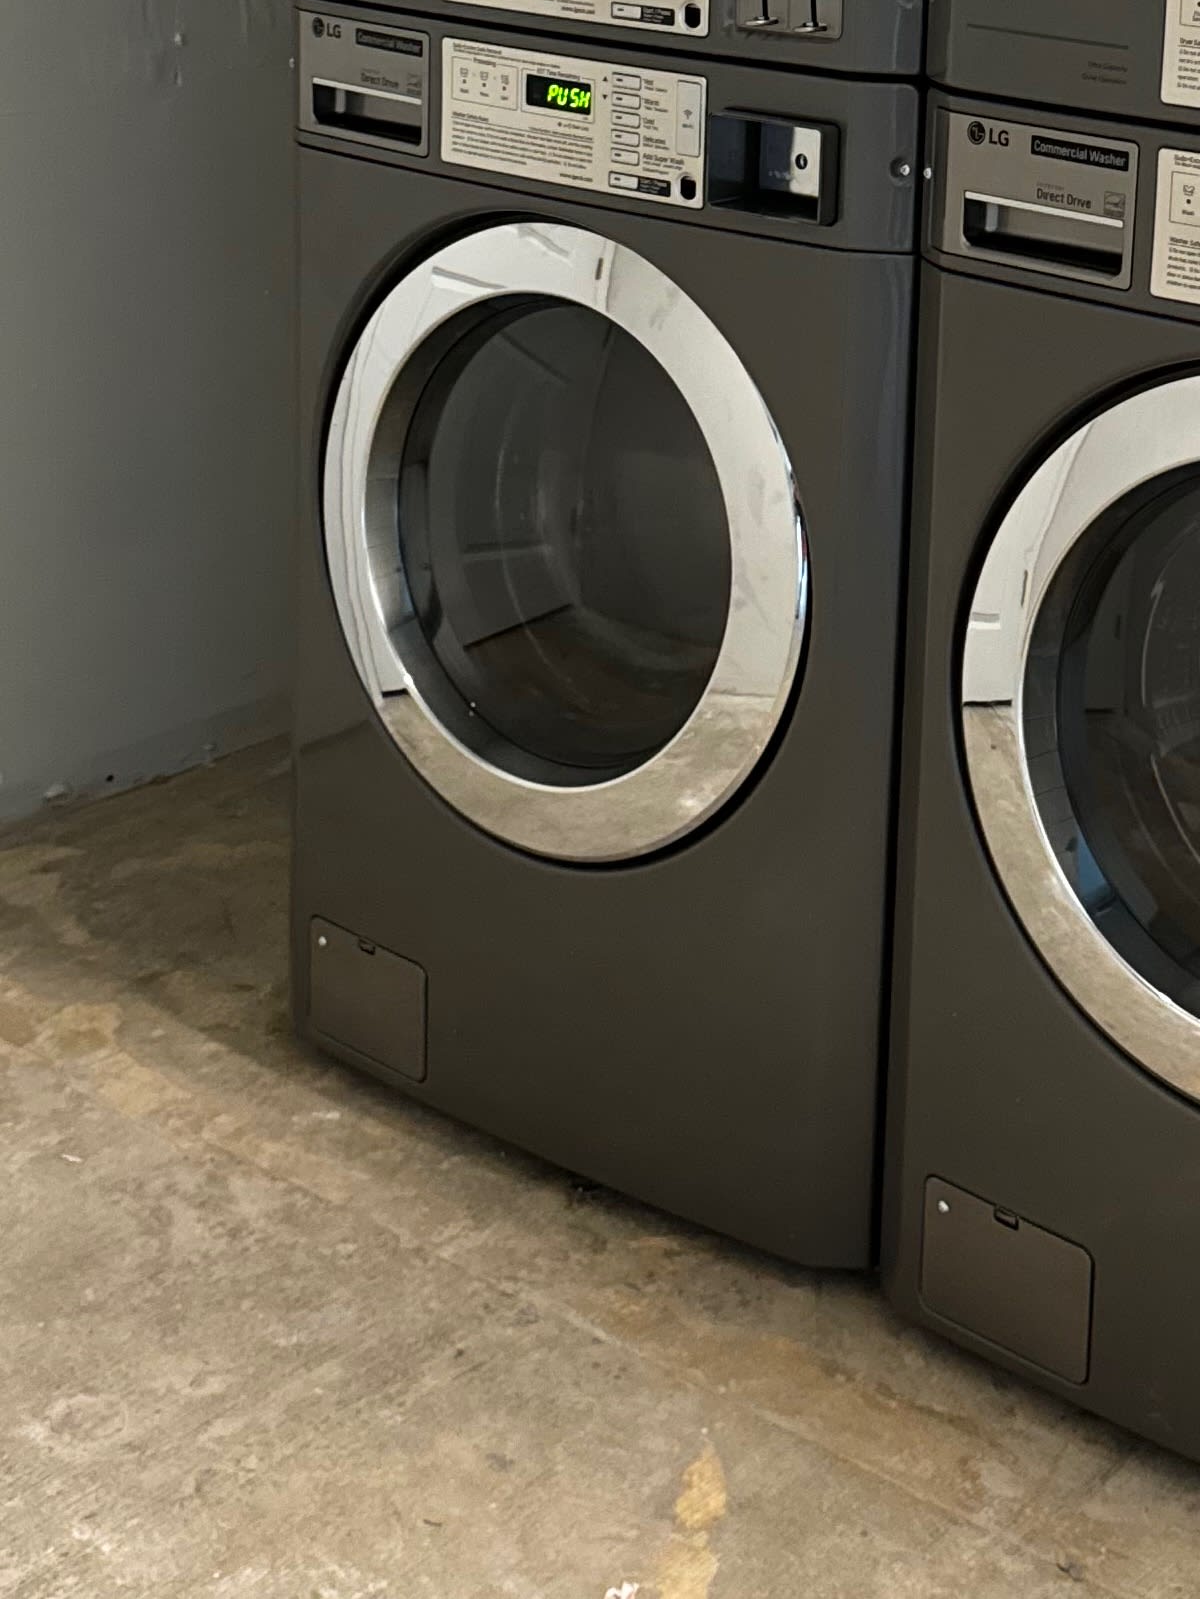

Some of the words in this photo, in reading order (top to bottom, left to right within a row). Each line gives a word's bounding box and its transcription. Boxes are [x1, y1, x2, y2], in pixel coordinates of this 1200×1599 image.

[327, 23, 341, 39] LG
[547, 84, 591, 108] PUSH
[989, 128, 1009, 147] LG
[1034, 139, 1088, 160] Commercial
[1089, 151, 1126, 167] Washer
[1037, 188, 1065, 205] Direct
[1067, 194, 1092, 209] Drive
